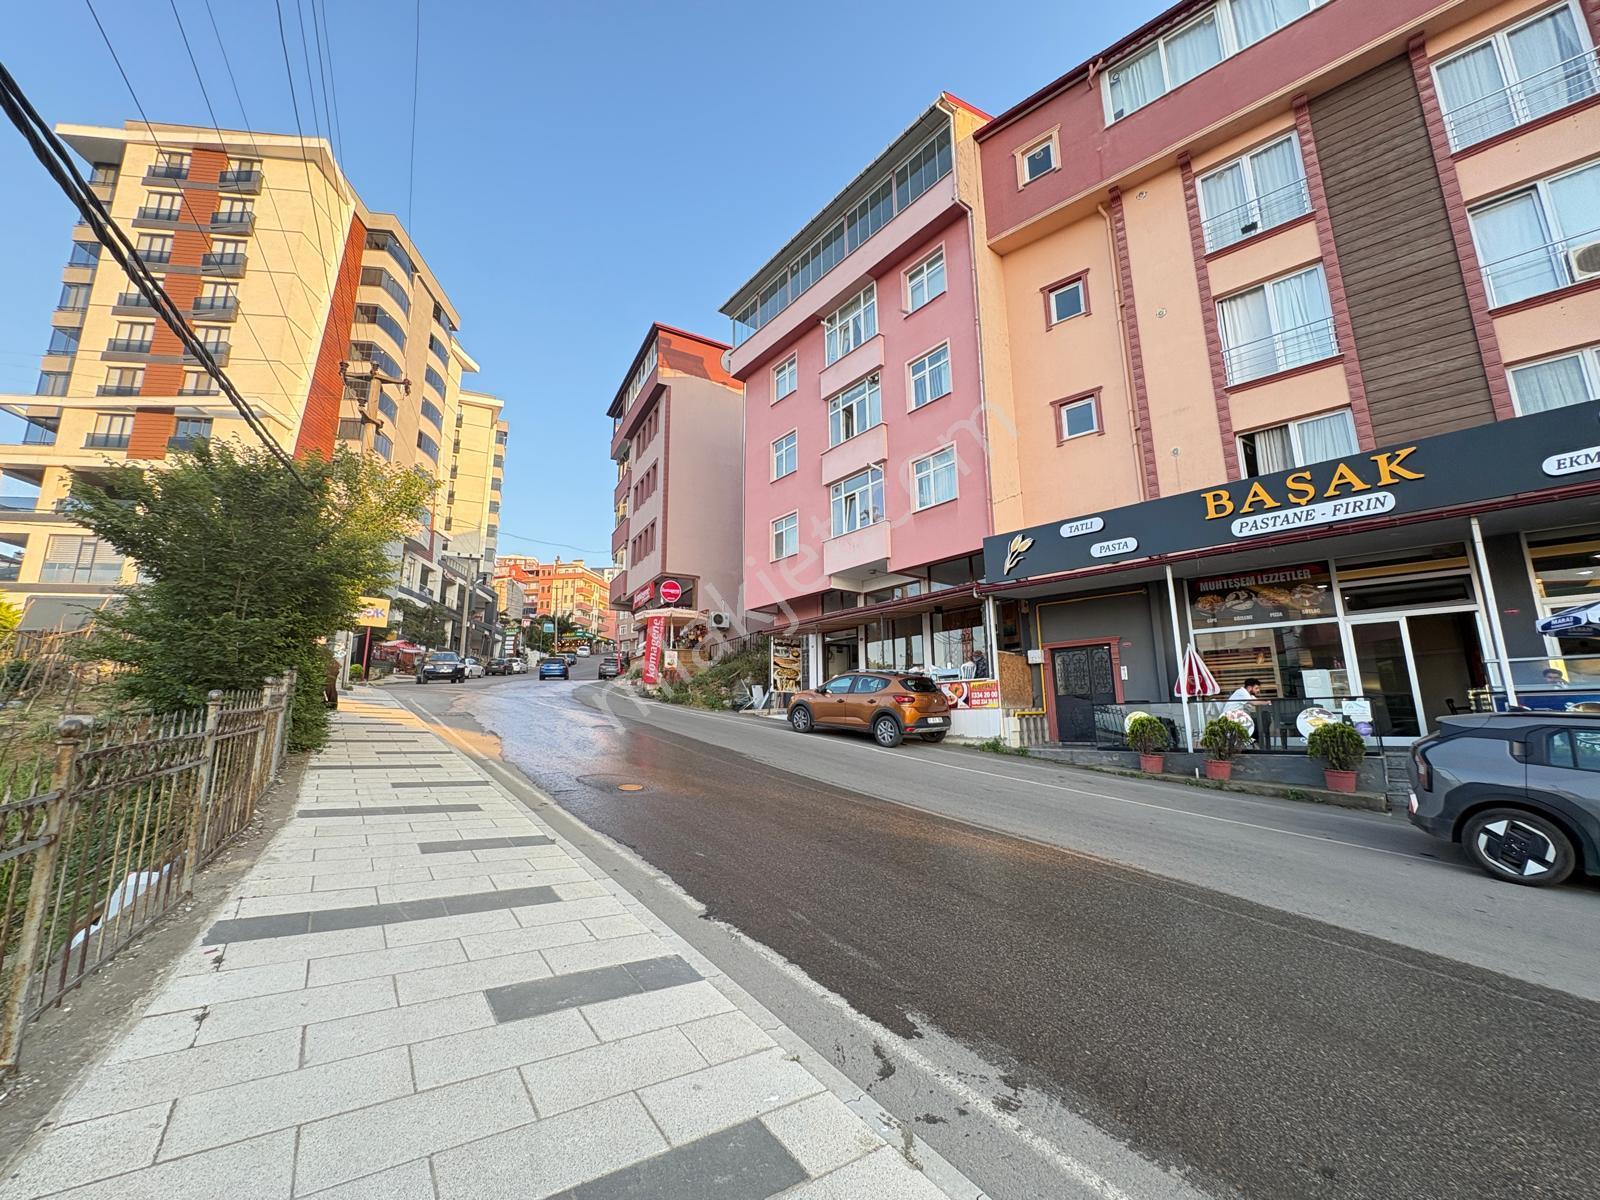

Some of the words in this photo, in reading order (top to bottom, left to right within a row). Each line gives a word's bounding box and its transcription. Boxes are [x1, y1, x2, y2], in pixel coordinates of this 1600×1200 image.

[1201, 446, 1424, 520] BAŞAK
[1068, 521, 1094, 534] TATLI
[1238, 508, 1315, 534] PASTANE
[1332, 495, 1388, 517] FIRIN
[1099, 541, 1129, 554] PASTA
[1257, 569, 1312, 585] LEZZETLER
[646, 618, 661, 678] komagene
